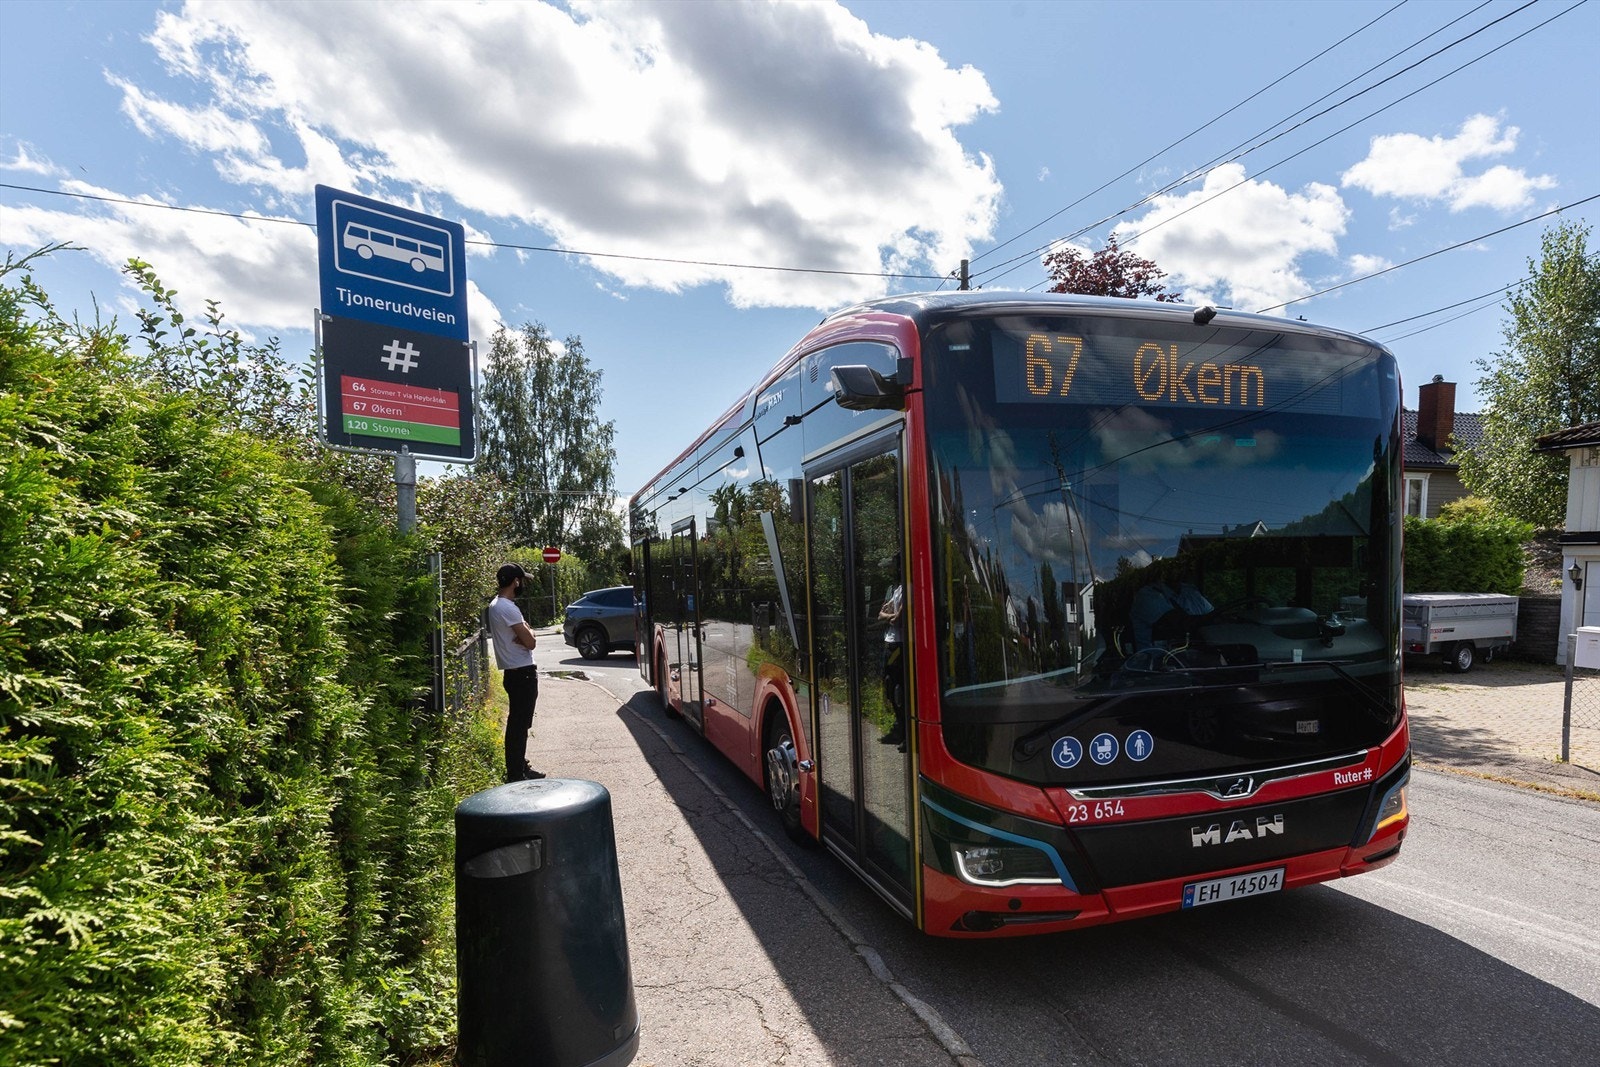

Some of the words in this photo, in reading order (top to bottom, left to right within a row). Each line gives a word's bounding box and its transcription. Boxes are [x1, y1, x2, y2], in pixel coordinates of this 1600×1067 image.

[336, 286, 456, 325] Tjonerudveien
[1026, 334, 1083, 396] 67
[1133, 342, 1264, 406] Økern
[352, 382, 366, 392] 64
[370, 387, 396, 397] Stovner
[353, 401, 366, 411] 67
[371, 404, 402, 416] Økern
[347, 420, 368, 430] 120
[1068, 805, 1089, 823] 23
[1094, 800, 1125, 819] 654
[1191, 814, 1284, 848] MAN
[1199, 883, 1221, 902] EH
[1229, 873, 1279, 896] 14504
